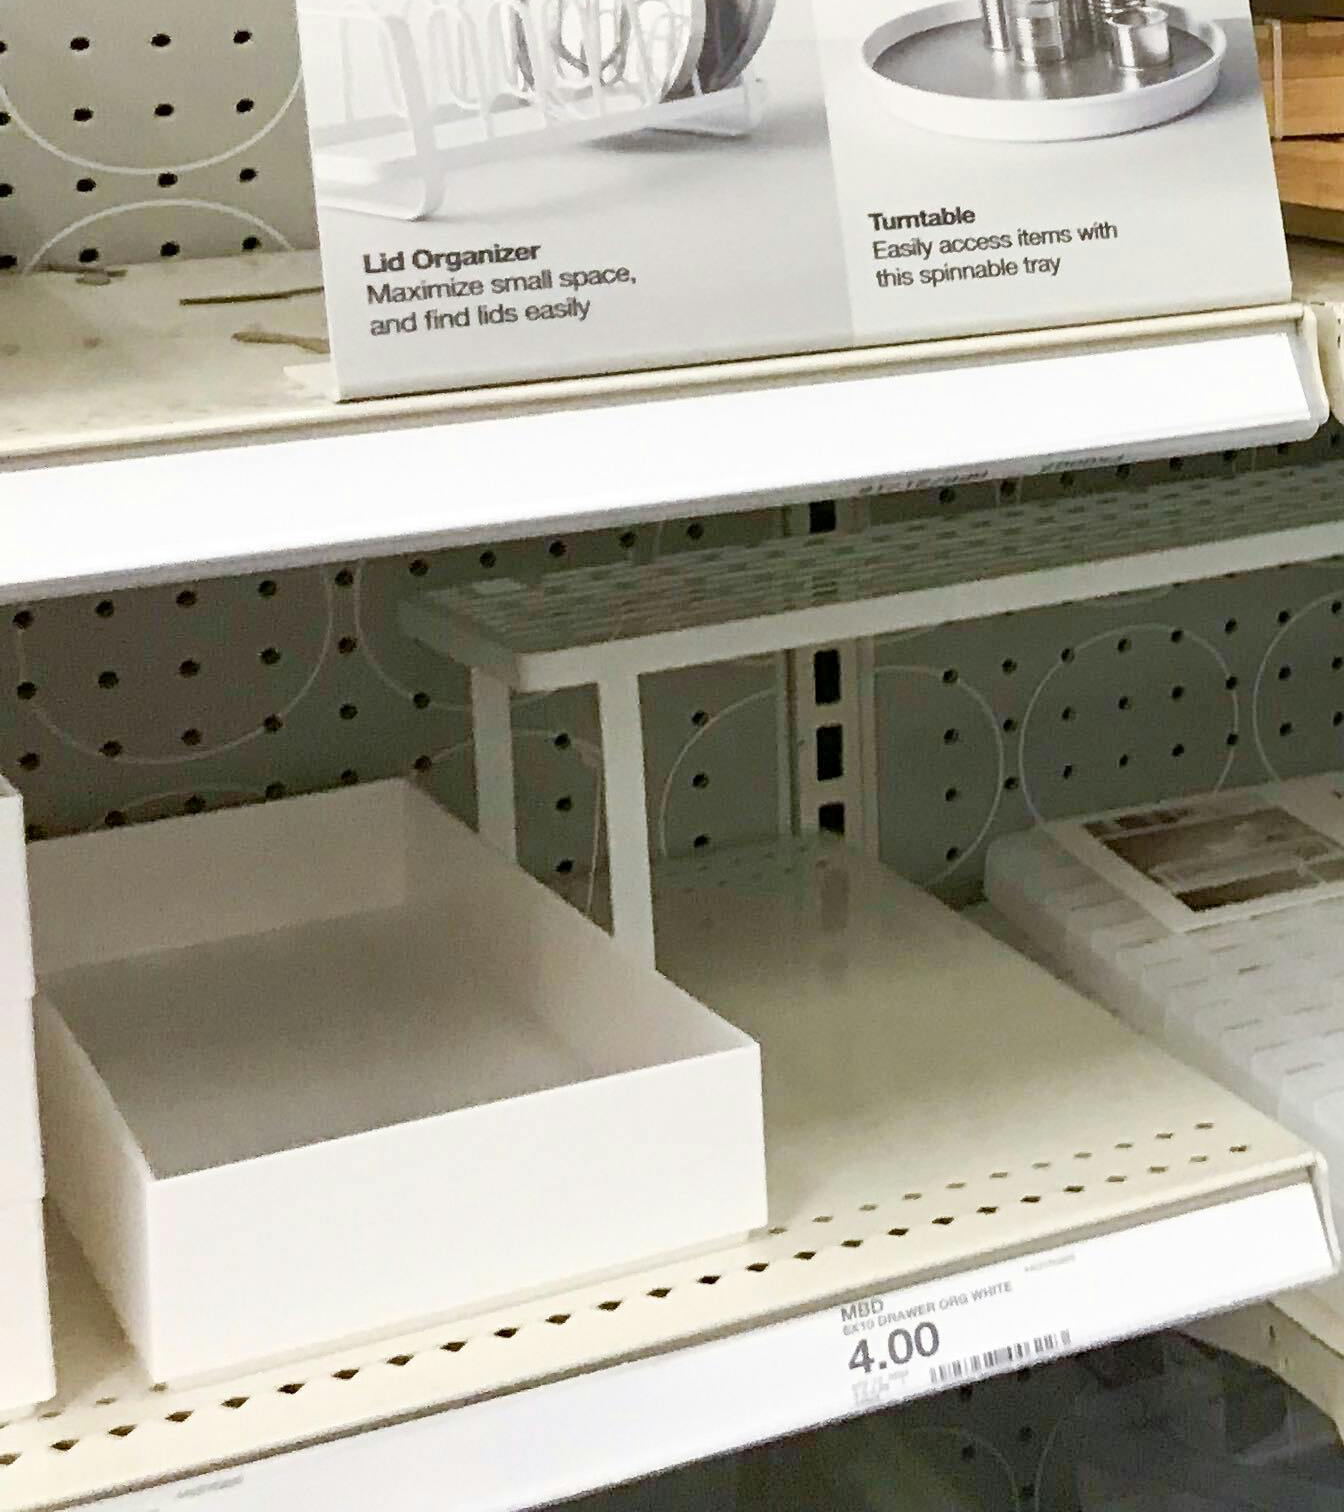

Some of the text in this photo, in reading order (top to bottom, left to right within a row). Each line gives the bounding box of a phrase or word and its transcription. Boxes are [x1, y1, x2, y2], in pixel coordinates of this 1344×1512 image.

[868, 207, 976, 232] Turntable
[362, 243, 542, 275] Lid Organizer
[872, 221, 1119, 261] Easily access items with
[366, 266, 637, 305] Maximize small space,
[875, 255, 1062, 288] this spinnable tray
[370, 296, 592, 337] and find lids easily
[840, 1297, 884, 1323] MBD
[877, 1301, 936, 1328] DRAWER
[970, 1280, 1013, 1303] WHITE
[848, 1320, 940, 1374] 4.00
